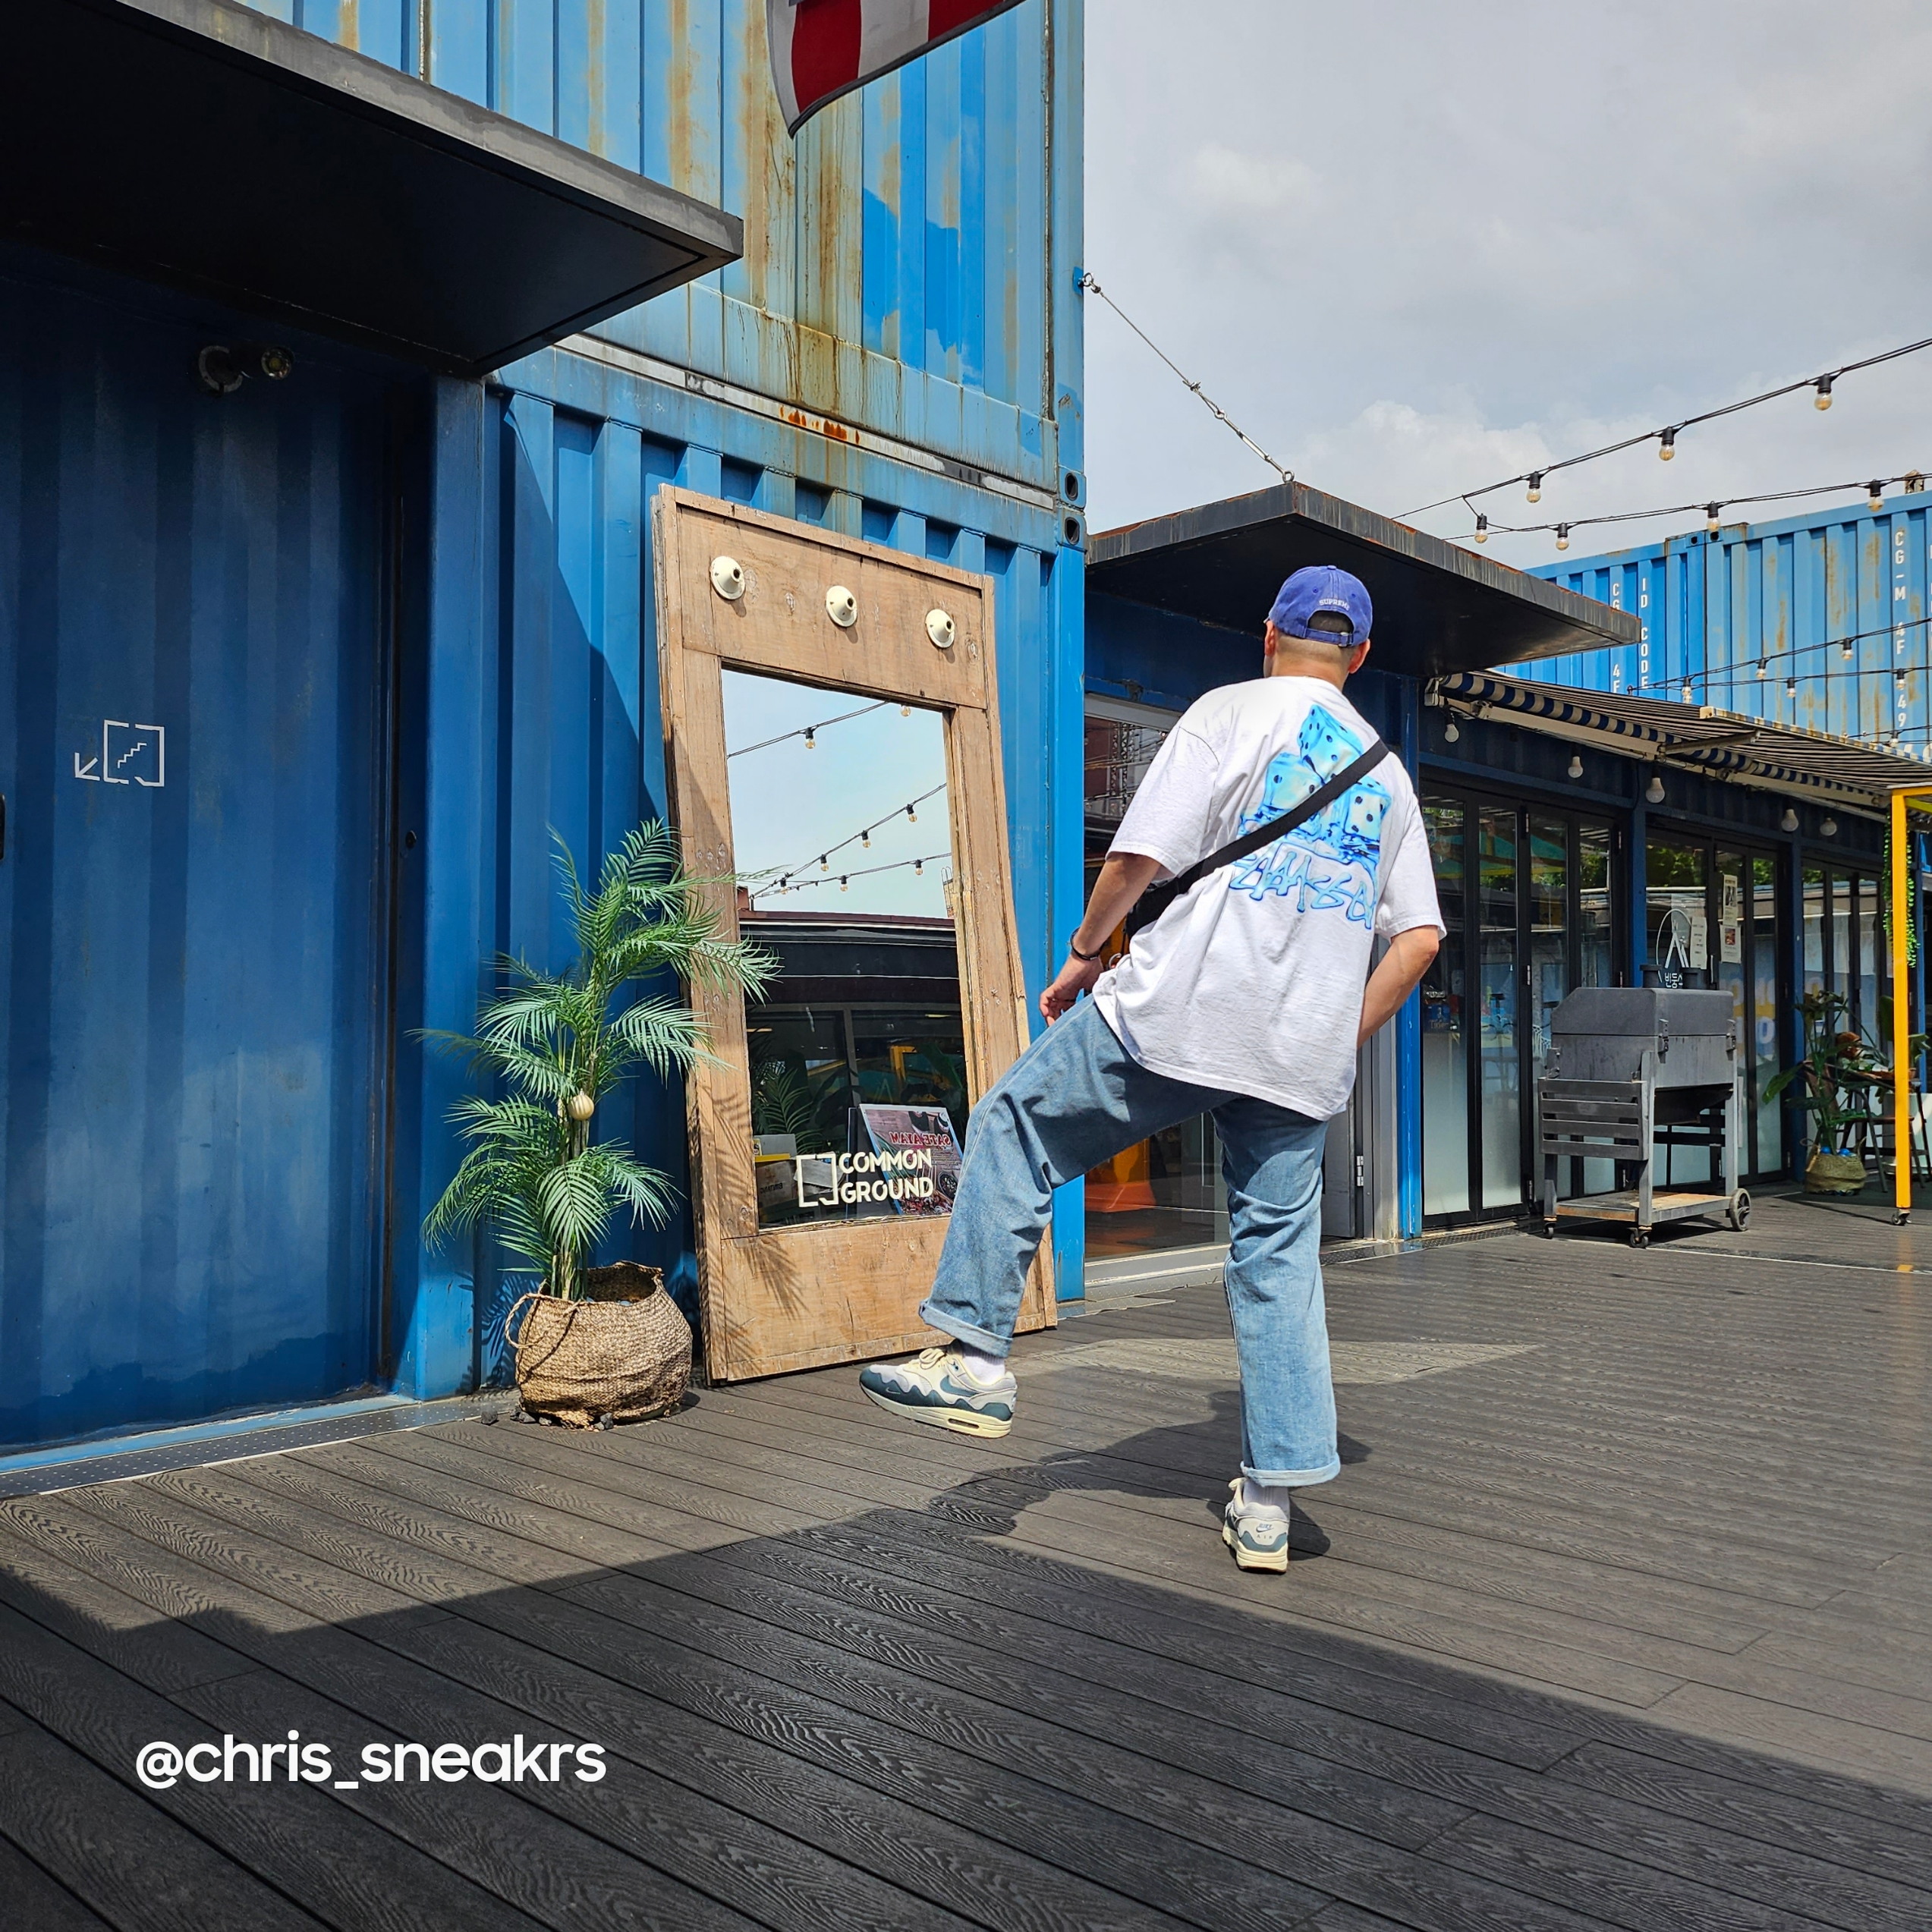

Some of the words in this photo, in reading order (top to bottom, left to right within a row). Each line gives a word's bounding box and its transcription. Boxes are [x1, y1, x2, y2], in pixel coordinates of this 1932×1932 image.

[1894, 531, 1906, 601] CG-M
[1641, 577, 1648, 609] ID
[1896, 621, 1905, 655] 4F
[1640, 627, 1649, 689] CODE
[839, 1148, 933, 1174] COMMON
[841, 1177, 933, 1204] GROUND
